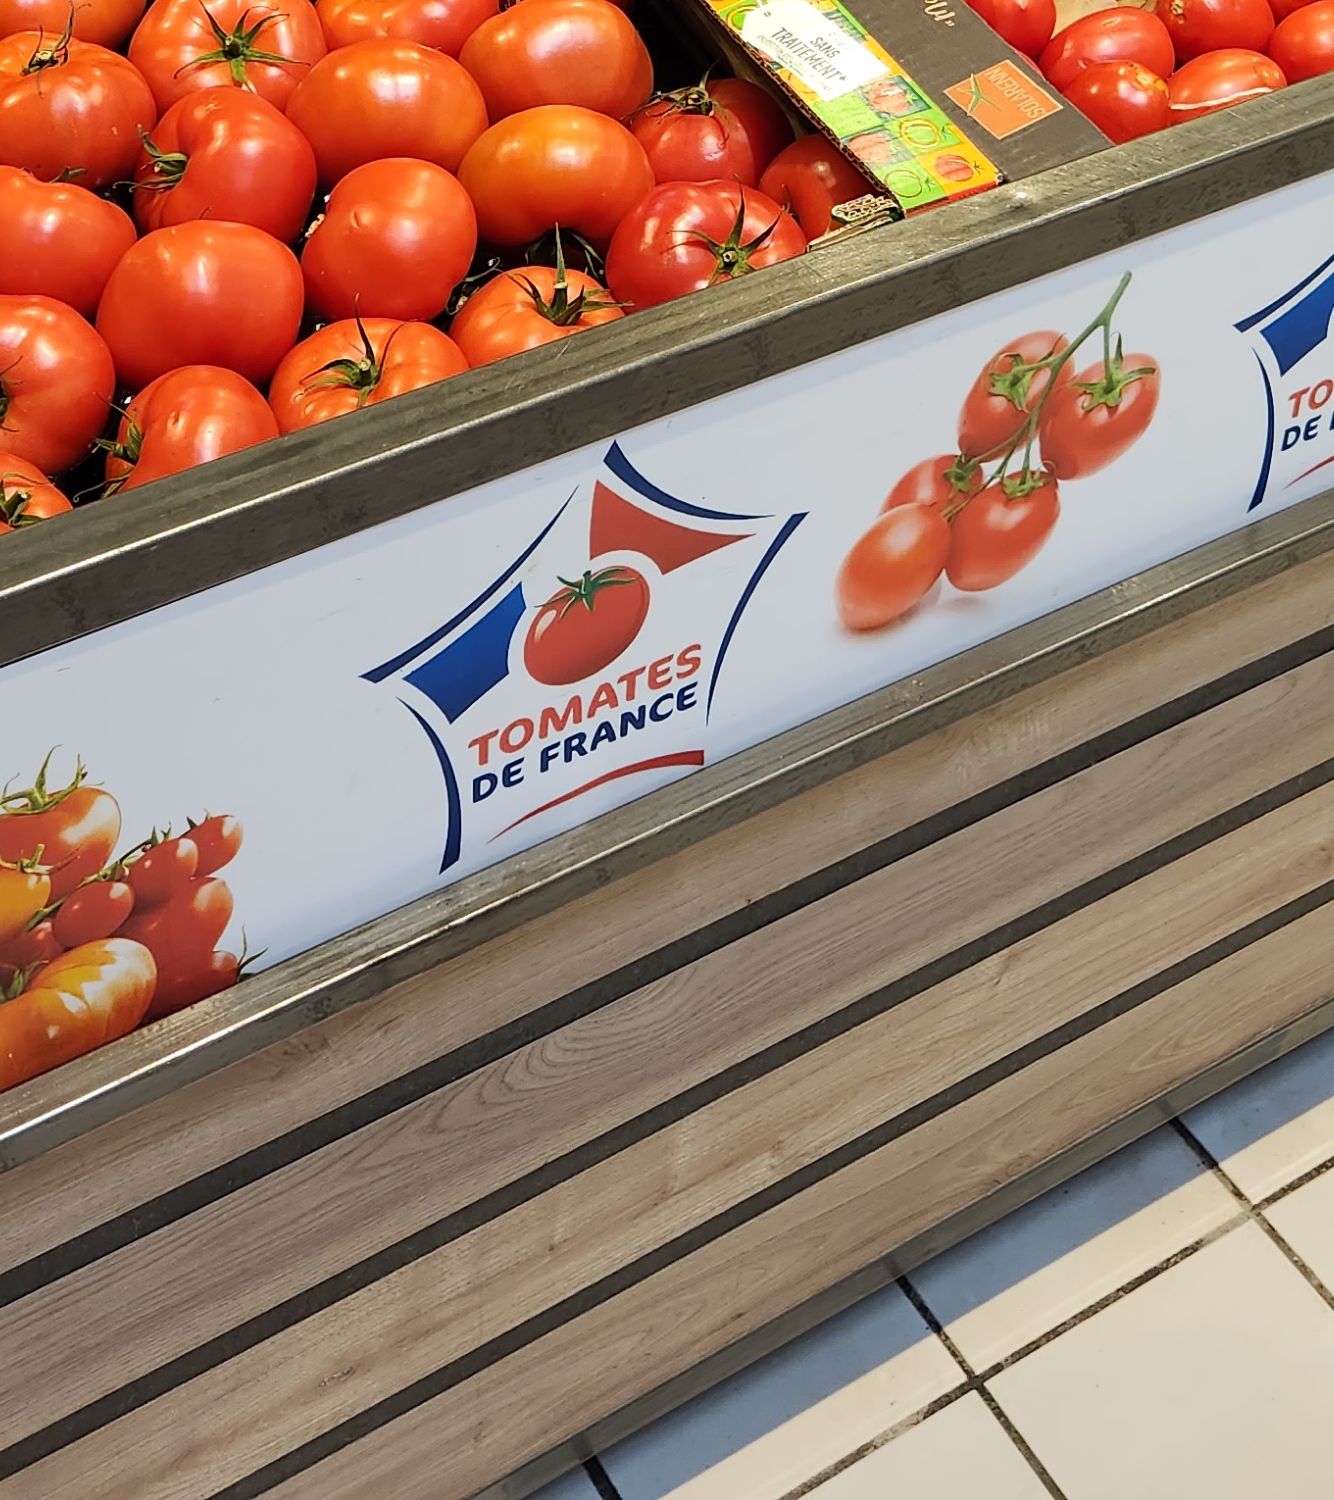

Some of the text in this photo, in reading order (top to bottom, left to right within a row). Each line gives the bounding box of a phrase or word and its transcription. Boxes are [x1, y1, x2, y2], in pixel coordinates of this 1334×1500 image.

[810, 36, 841, 59] SANS
[984, 67, 1047, 119] SOLARENN
[1280, 421, 1319, 452] DE
[468, 643, 703, 768] TOMATES
[472, 681, 699, 804] DE FRANCE
